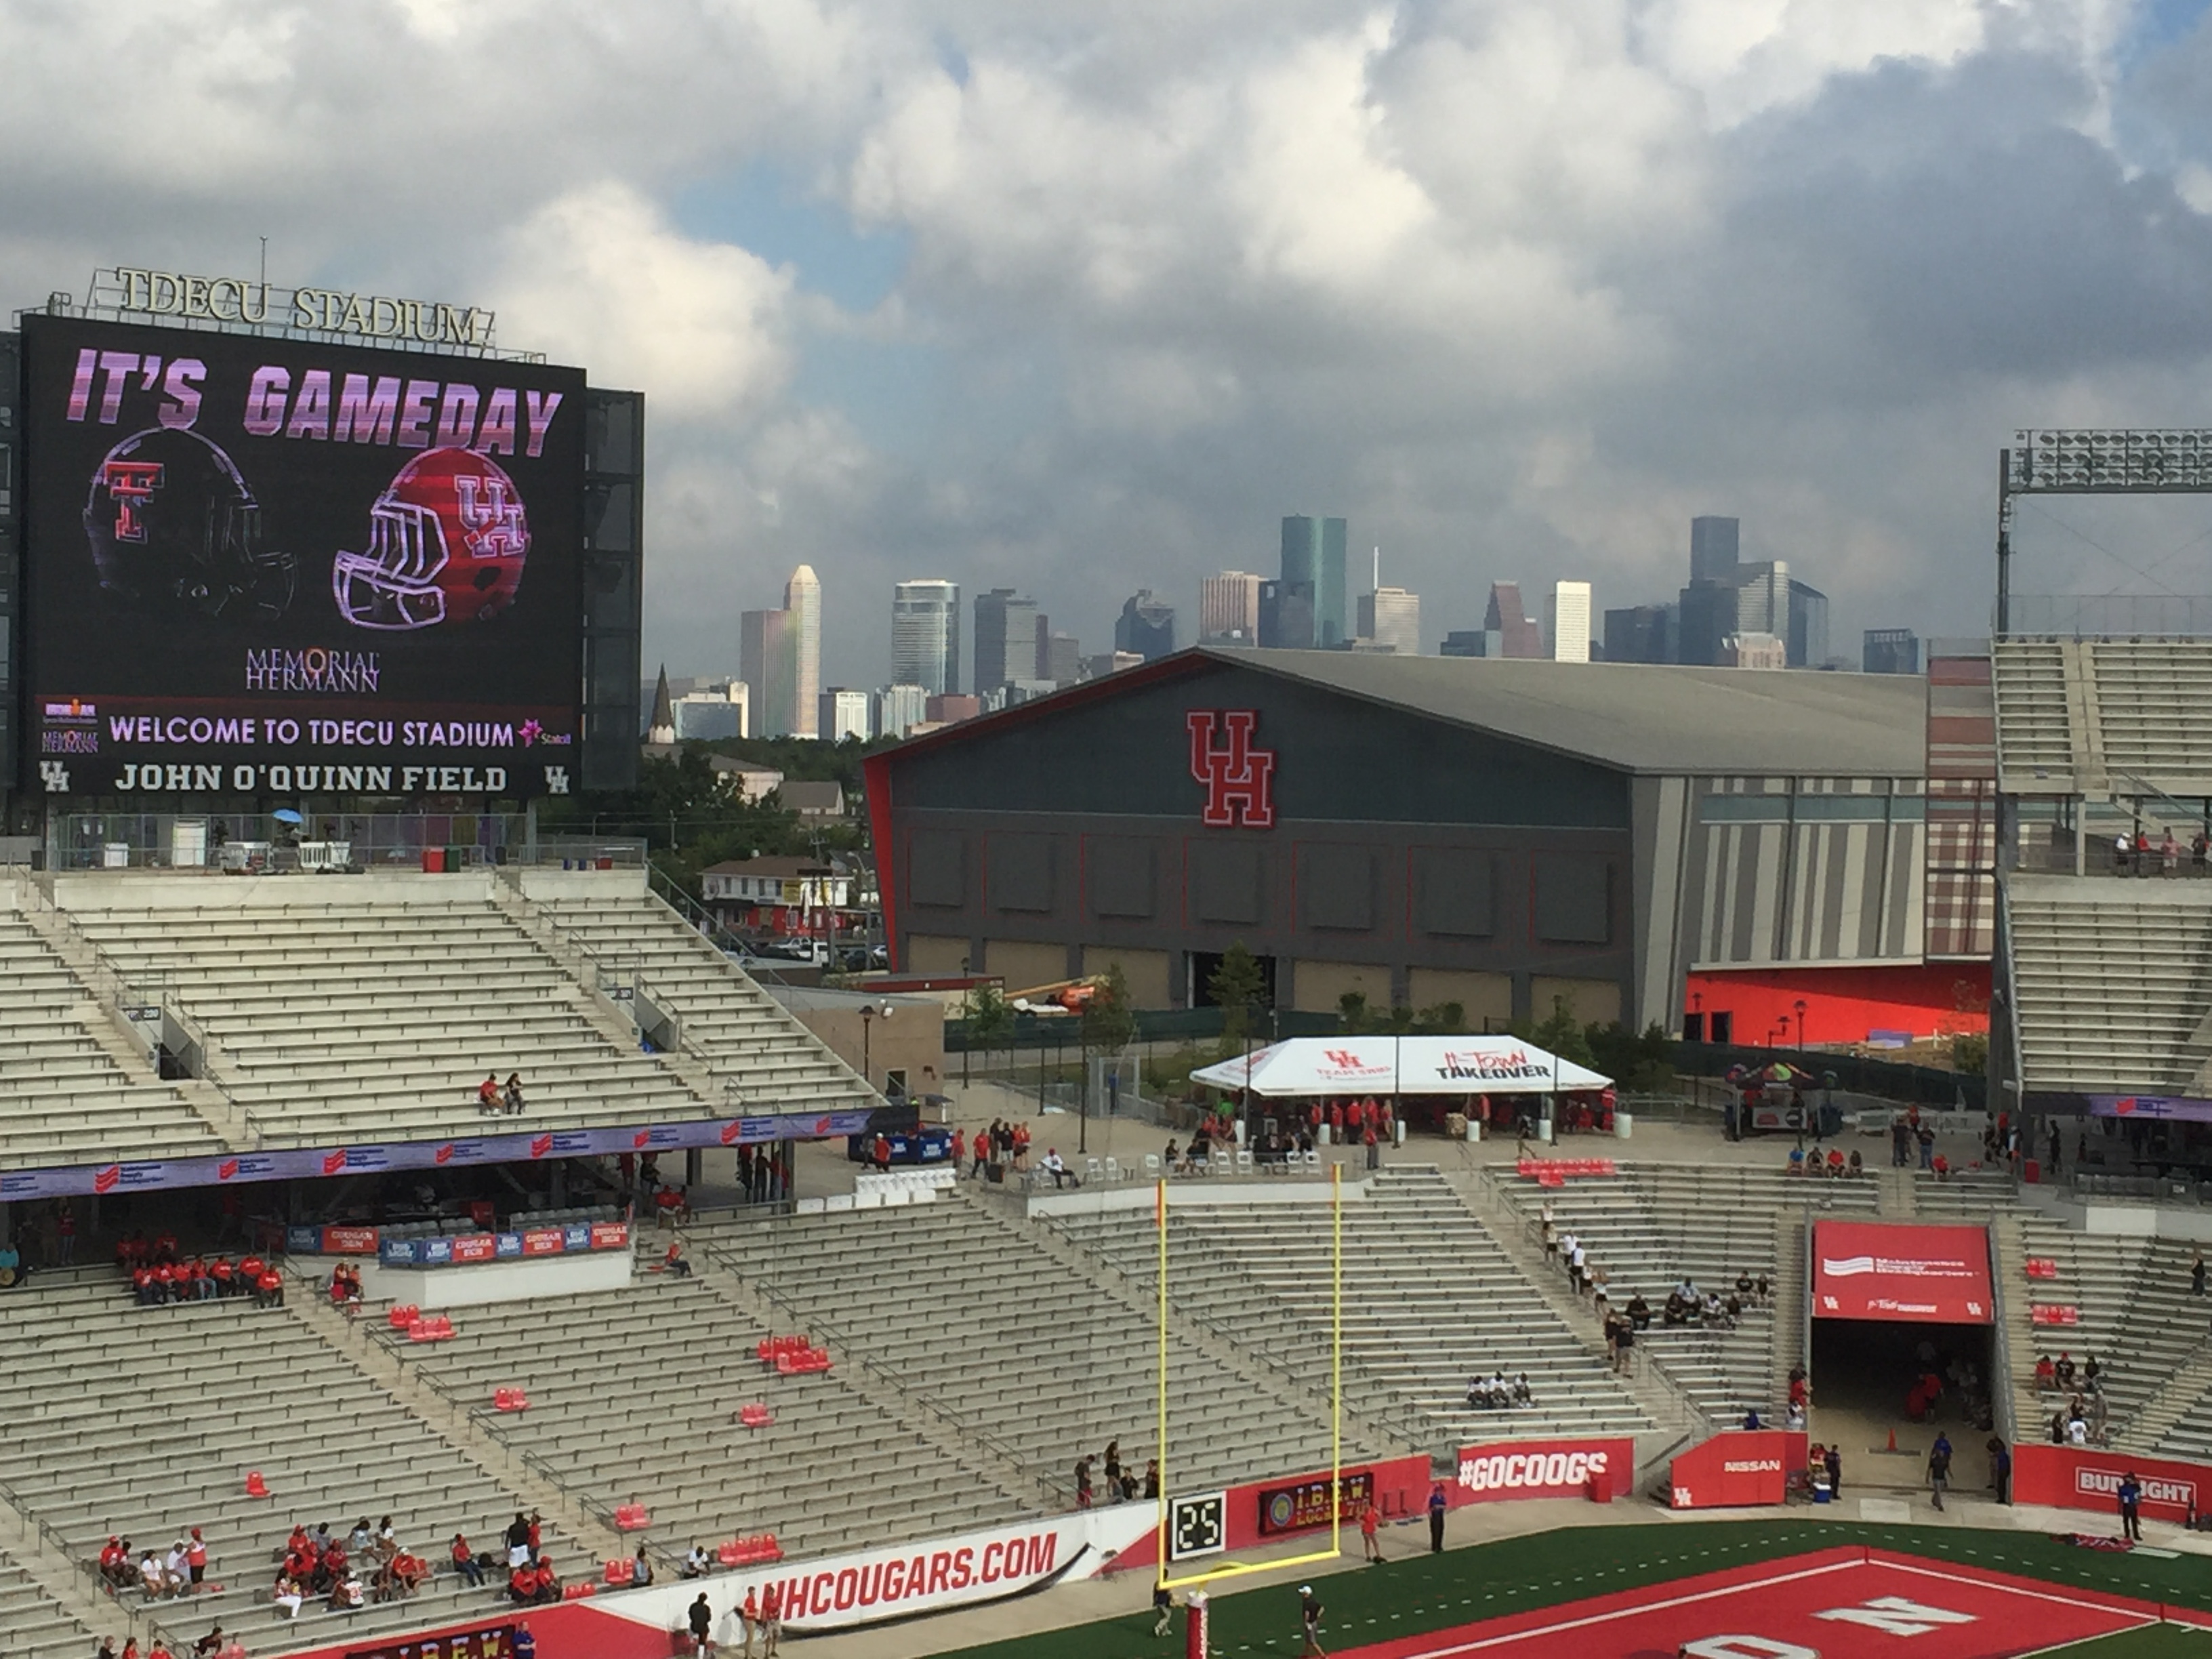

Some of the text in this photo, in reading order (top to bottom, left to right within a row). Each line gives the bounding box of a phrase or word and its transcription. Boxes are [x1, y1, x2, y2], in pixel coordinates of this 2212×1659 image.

[117, 267, 483, 345] TDECU STADIUM
[66, 348, 564, 457] IT'S GAMEDAY
[245, 648, 377, 673] MEMORIAL
[245, 668, 378, 693] HERMANN
[109, 716, 514, 747] WELCOME TO TDECU STADIUM
[115, 764, 508, 792] JOHN O'QUINN FIELD
[1435, 1065, 1551, 1080] TAKEOVER
[1458, 1452, 1608, 1492] #GOCOOGS
[1724, 1460, 1781, 1473] NISSAN
[2136, 1479, 2192, 1502] IGHT
[1179, 1501, 1218, 1549] 25
